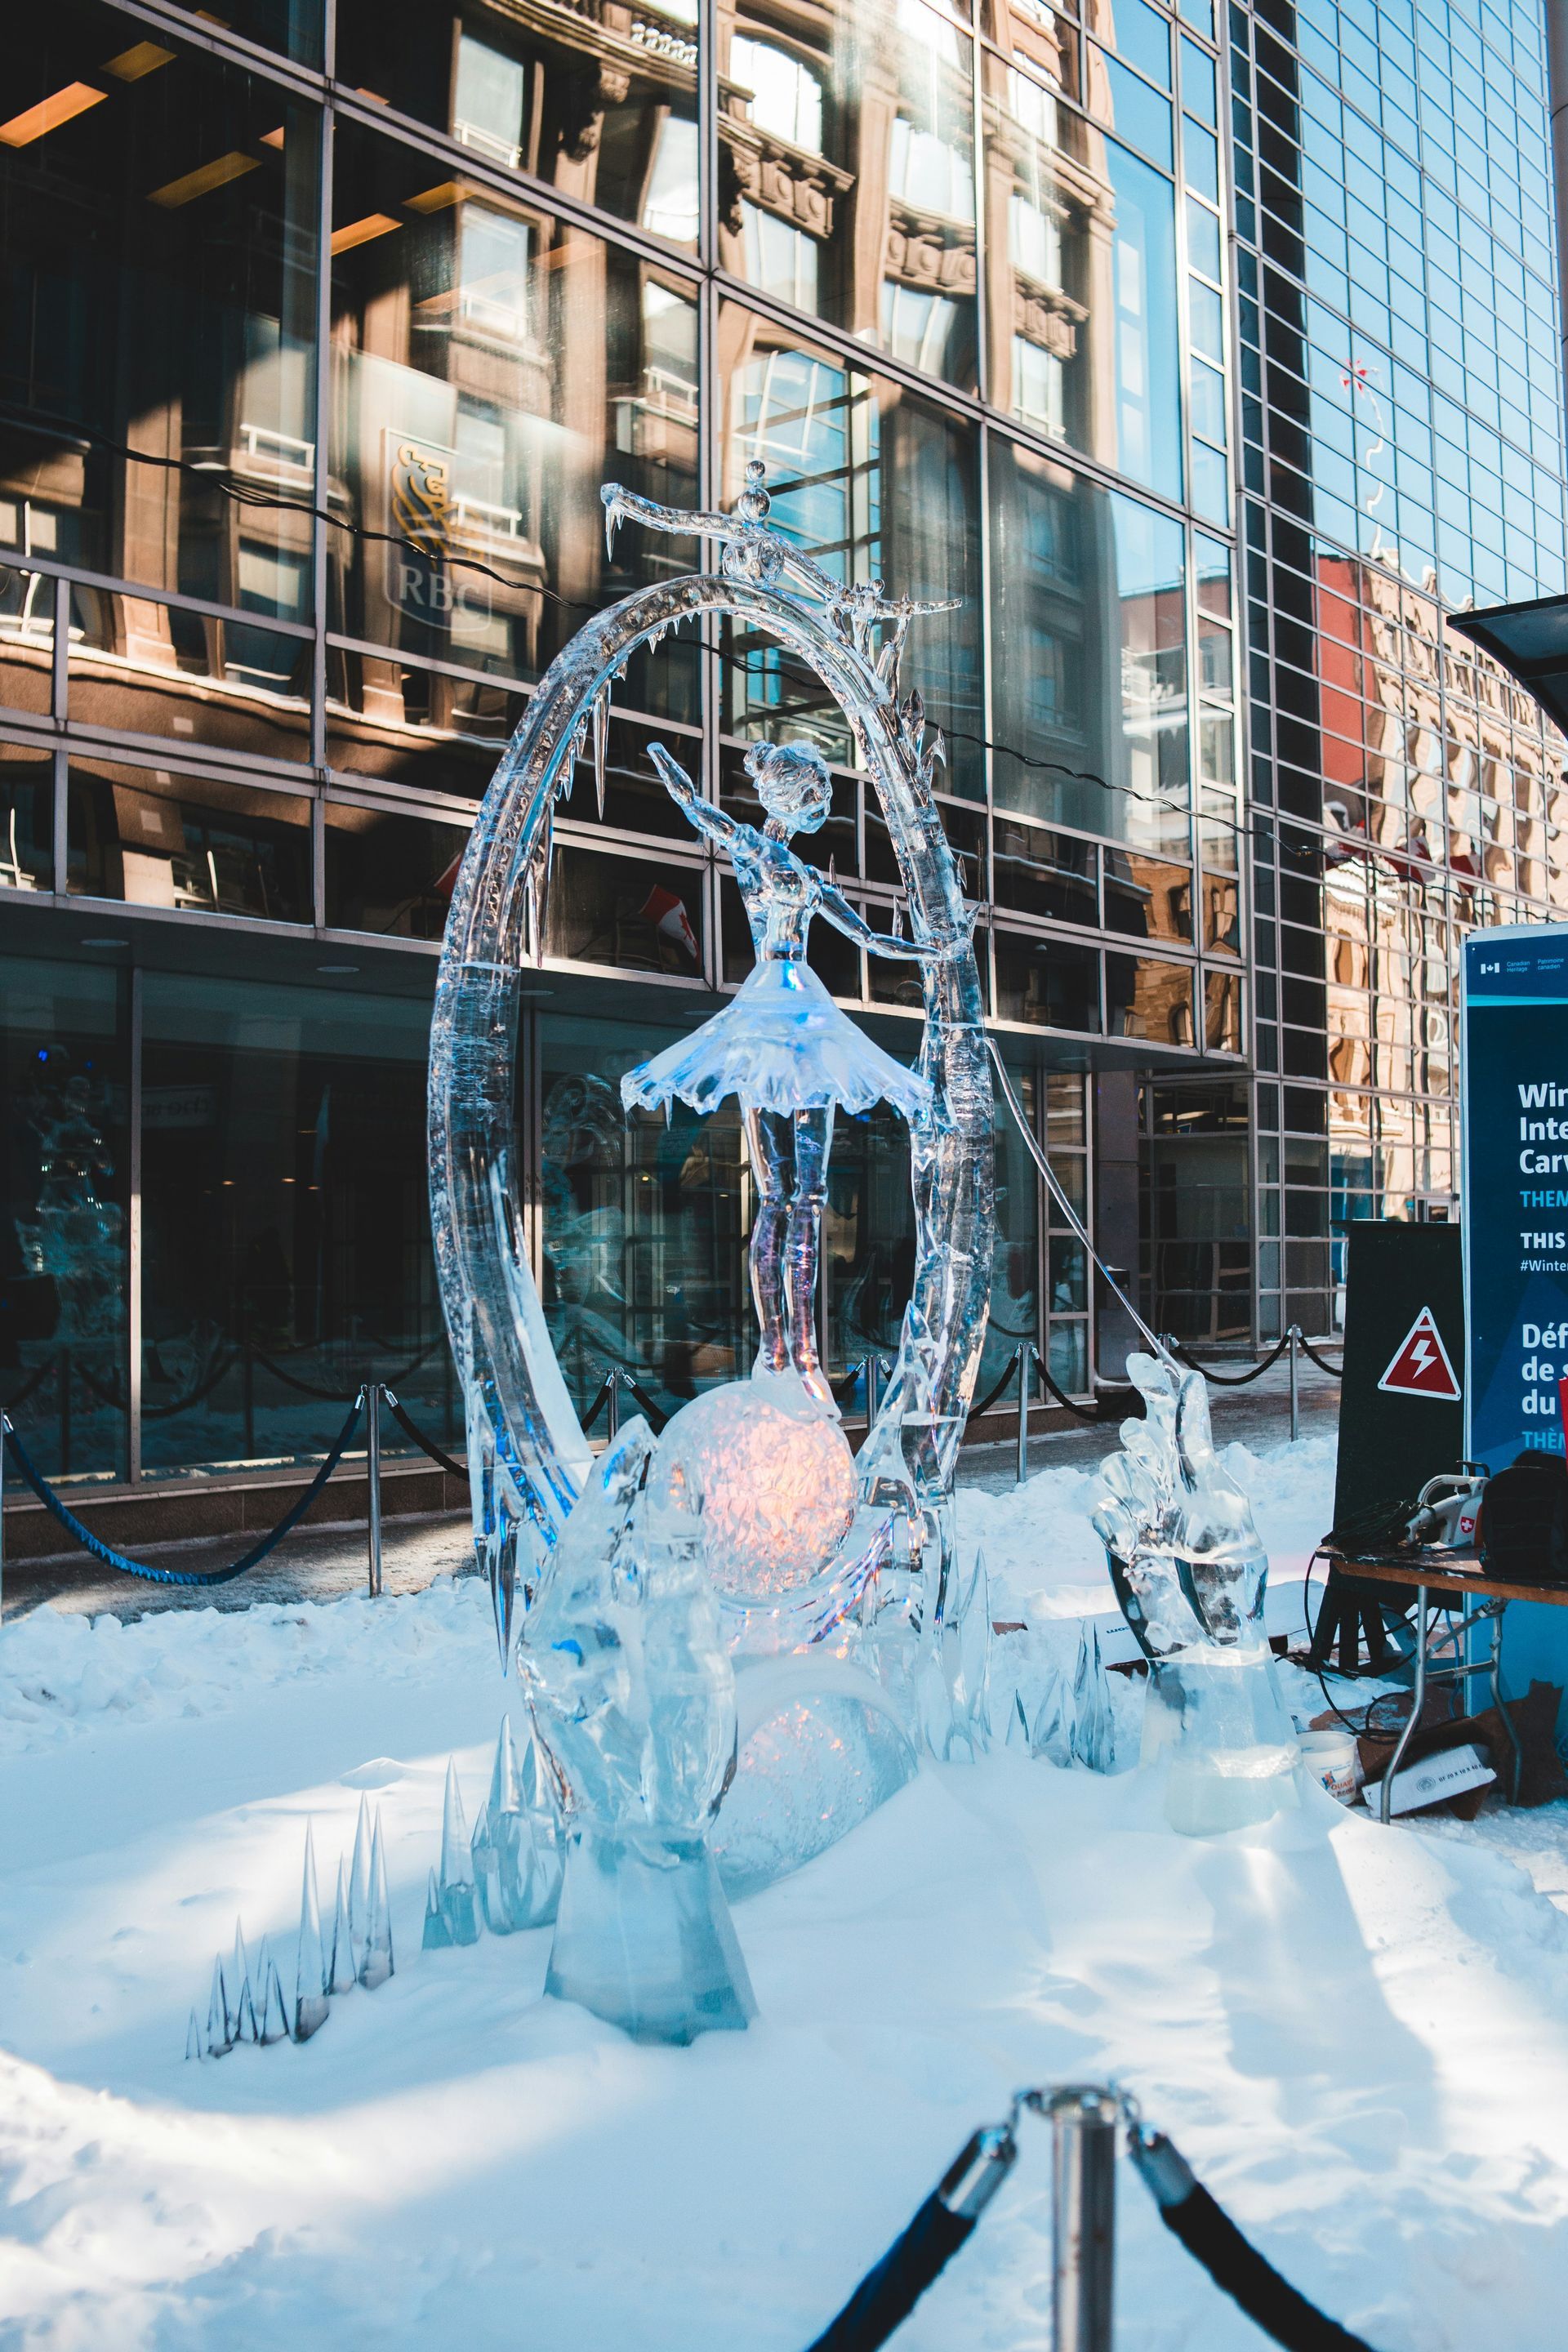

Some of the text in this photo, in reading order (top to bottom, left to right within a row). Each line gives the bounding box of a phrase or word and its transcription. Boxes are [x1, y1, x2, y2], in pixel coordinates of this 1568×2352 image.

[399, 564, 481, 618] RBC
[1520, 1116, 1568, 1141] Inte
[1520, 1232, 1566, 1250] THIS
[1520, 1259, 1568, 1272] #Winte
[1522, 1322, 1568, 1349] Déf
[1521, 1356, 1555, 1382] de
[1521, 1389, 1556, 1415] du
